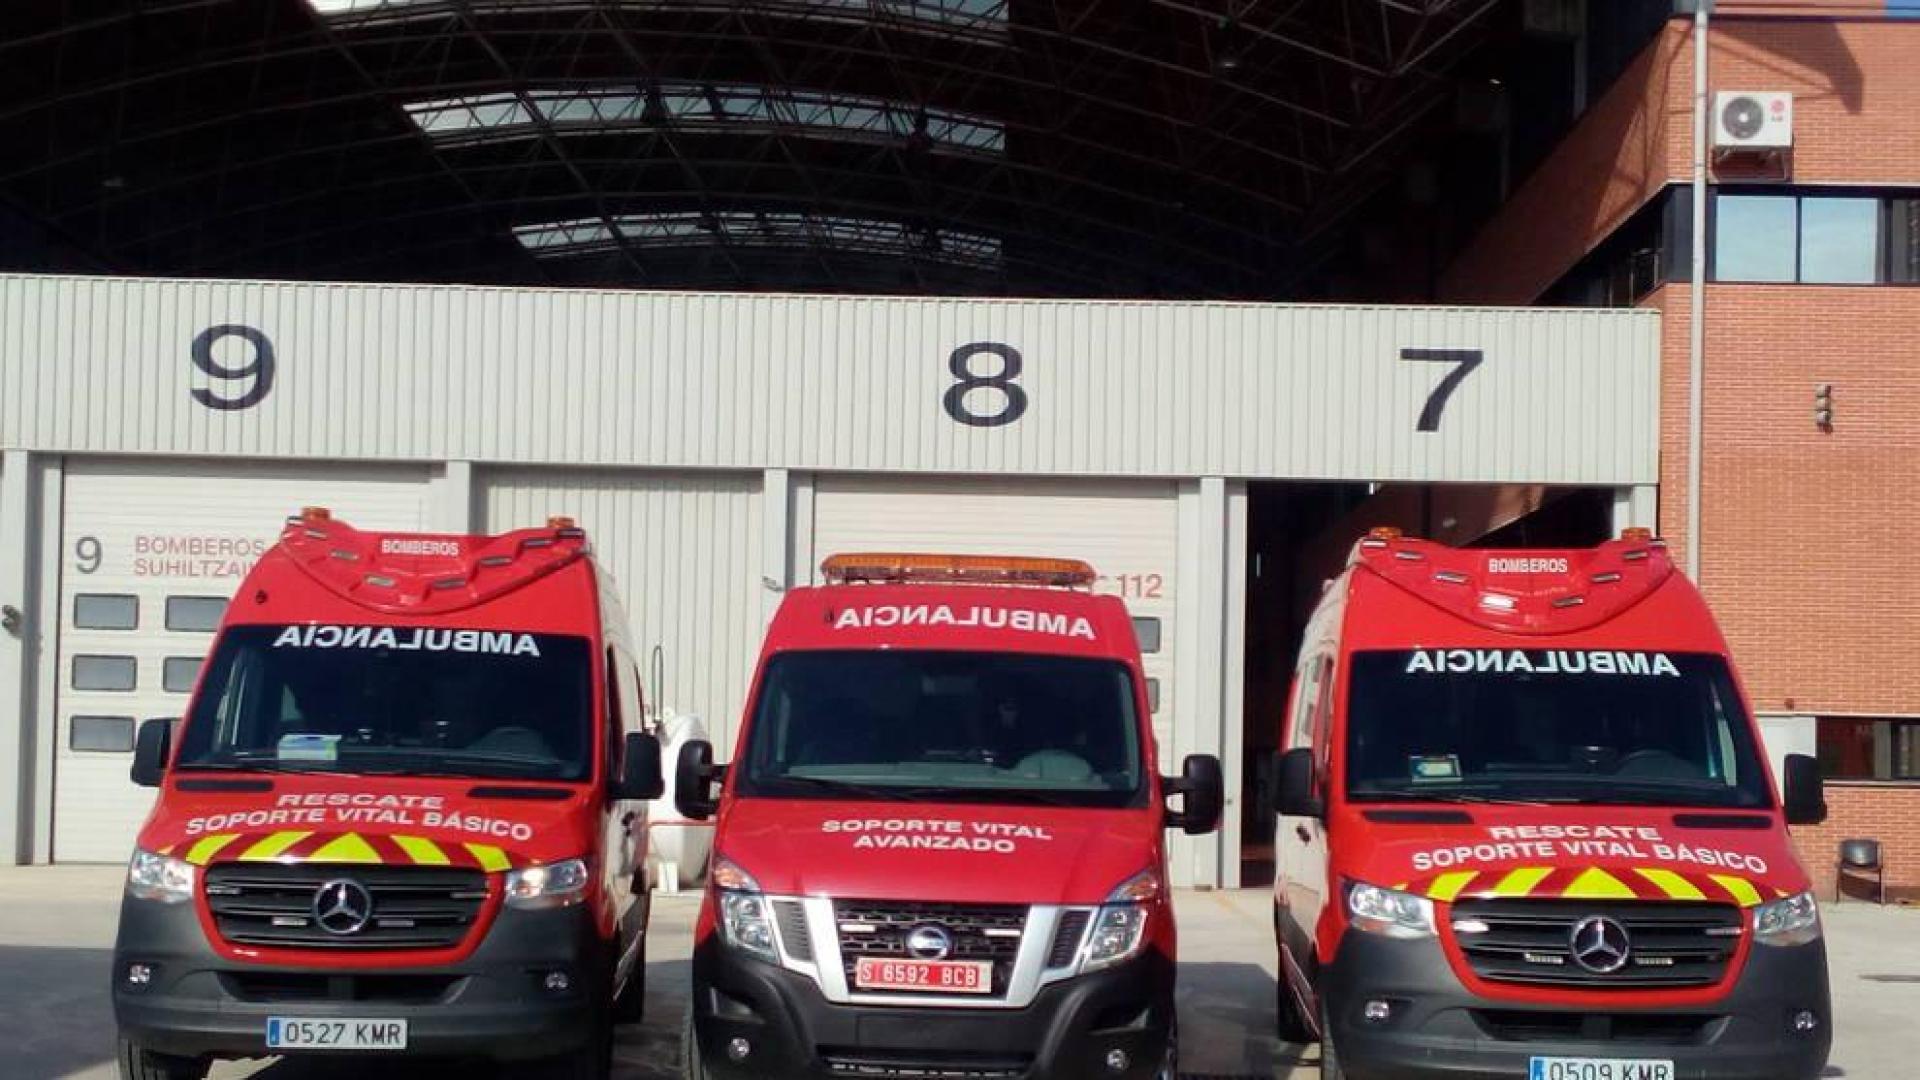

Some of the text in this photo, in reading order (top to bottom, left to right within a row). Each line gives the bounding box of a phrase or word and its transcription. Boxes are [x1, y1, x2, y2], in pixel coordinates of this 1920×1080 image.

[190, 323, 275, 411] 9
[943, 341, 1027, 427] 8
[1400, 348, 1484, 432] 7
[76, 536, 102, 574] 9
[134, 535, 265, 556] BOMBEROS
[381, 538, 459, 556] BOMBEROS
[133, 557, 253, 577] SUHILTZAI
[1488, 557, 1568, 573] BOMBEROS
[1116, 573, 1162, 598] 112
[276, 793, 444, 810] RESCATE
[185, 807, 327, 835] SOPORTE
[336, 807, 414, 825] VITAL
[821, 819, 1053, 840] SOPORTE VITAL
[853, 834, 1016, 853] AVANZADO
[1488, 825, 1664, 842] RESCATE
[1412, 841, 1557, 870] SOPORTE
[1562, 840, 1648, 858] VITAL
[285, 1021, 401, 1044] 0527 KMR
[1550, 1061, 1669, 1080] 0509 KMR
